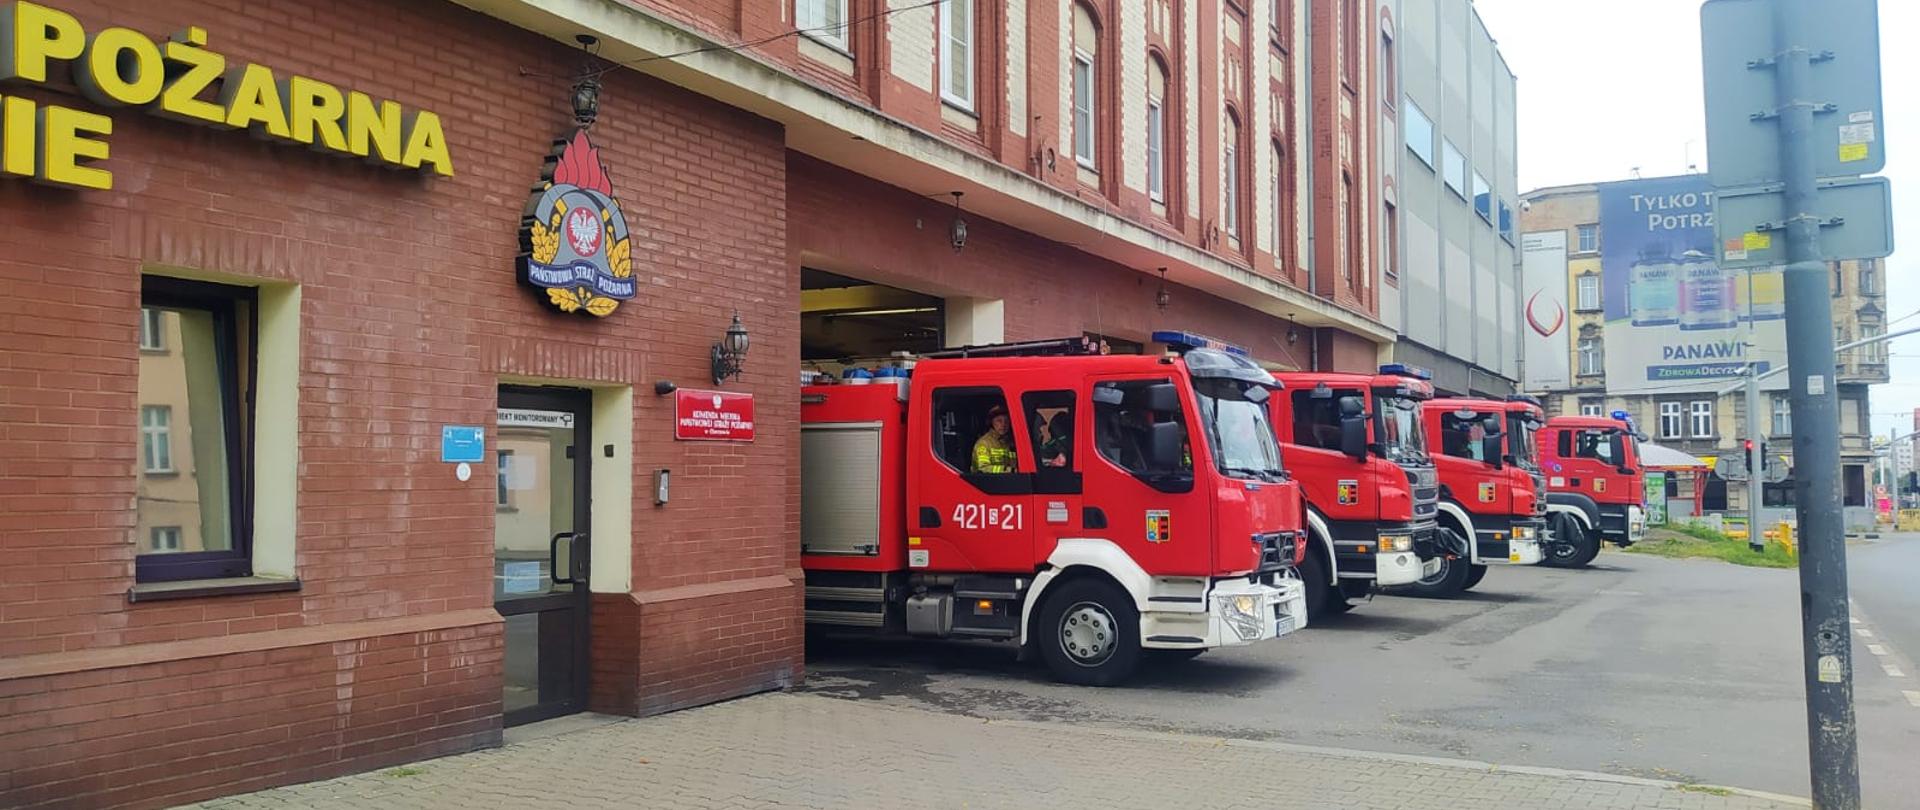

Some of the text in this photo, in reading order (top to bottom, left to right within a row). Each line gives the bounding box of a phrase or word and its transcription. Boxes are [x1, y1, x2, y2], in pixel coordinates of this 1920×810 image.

[15, 0, 454, 177] POŻARNA
[0, 94, 113, 190] IE
[1629, 191, 1714, 212] TYLKO T
[1648, 212, 1714, 232] POTRZ
[530, 264, 633, 296] PAŃSTWOWA STRAŻ POŻARNA
[1663, 341, 1746, 361] PANAWI
[952, 503, 986, 529] 421
[1001, 503, 1023, 530] 21
